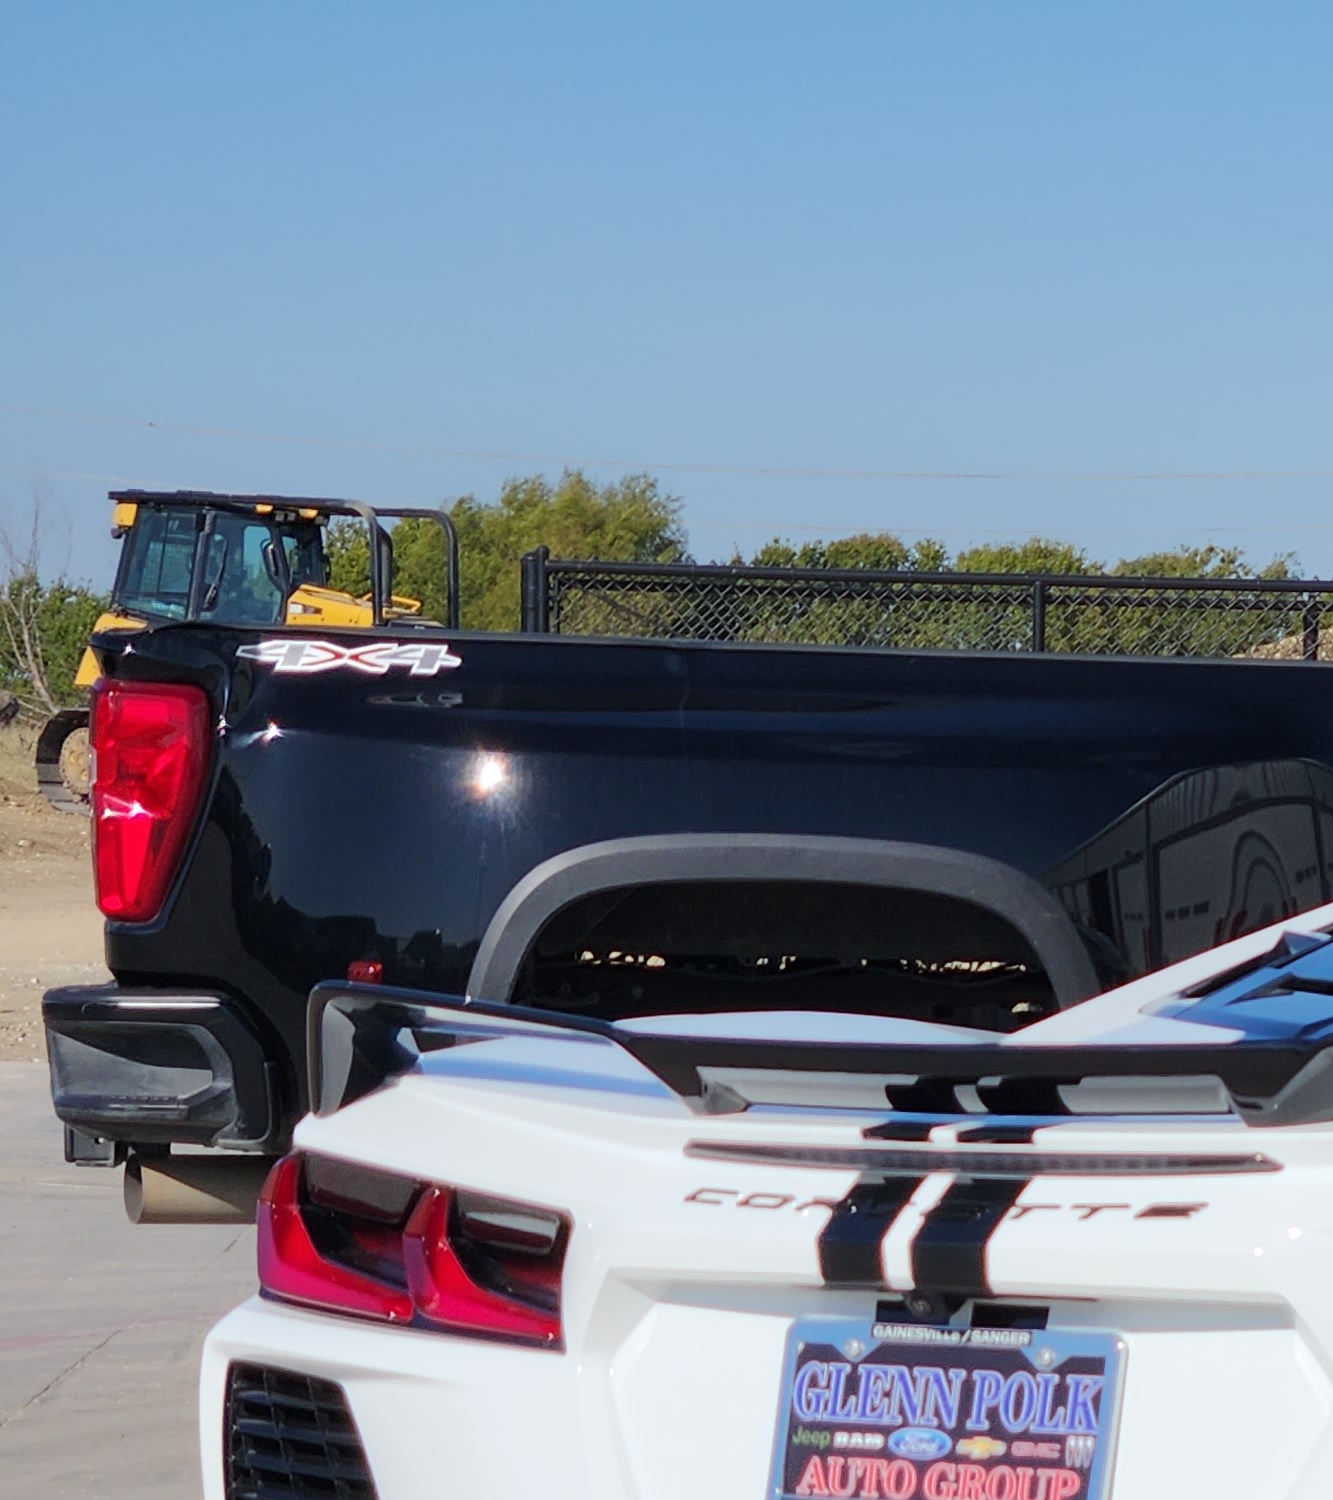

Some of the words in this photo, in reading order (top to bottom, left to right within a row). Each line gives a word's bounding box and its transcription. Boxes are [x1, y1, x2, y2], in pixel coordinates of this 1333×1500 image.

[684, 1186, 1207, 1222] CORTTE
[791, 1360, 965, 1428] GLENN
[968, 1369, 1104, 1433] POLK
[898, 1430, 940, 1454] Ford
